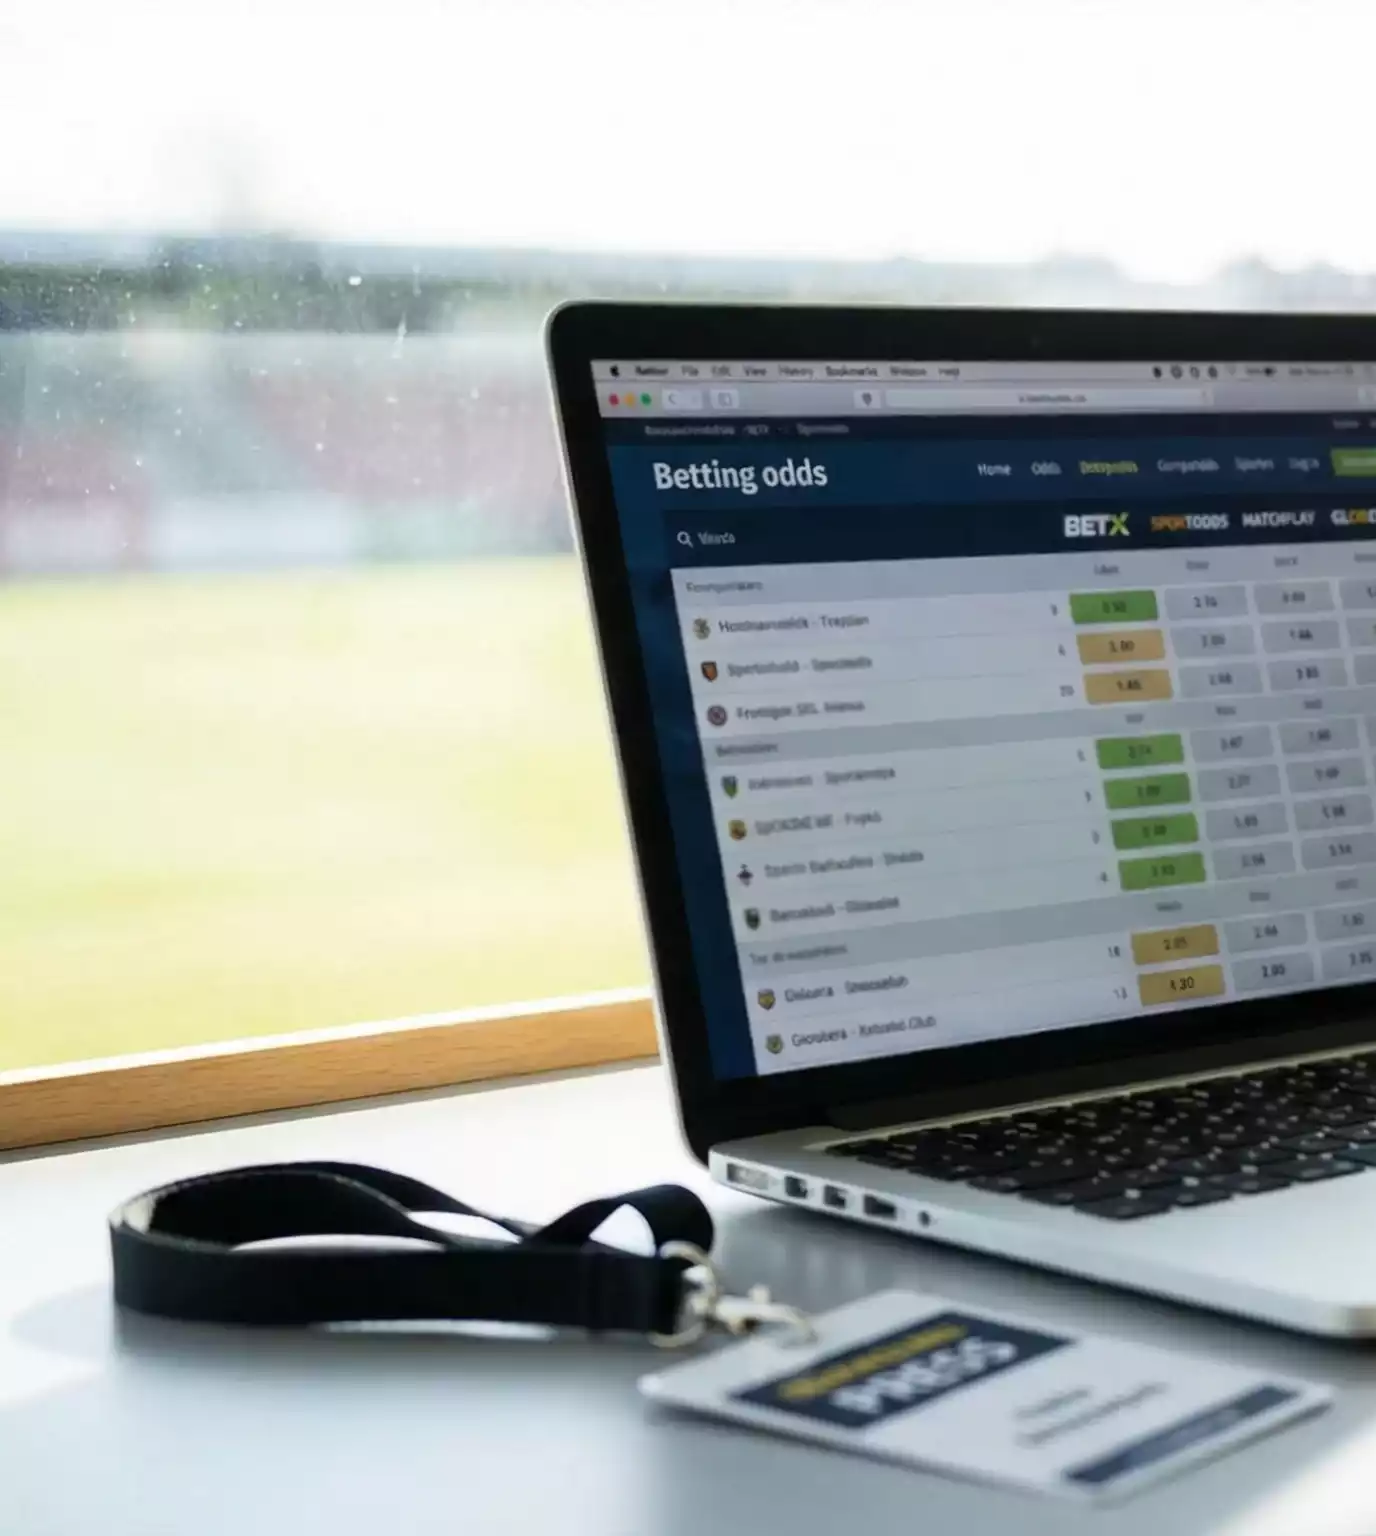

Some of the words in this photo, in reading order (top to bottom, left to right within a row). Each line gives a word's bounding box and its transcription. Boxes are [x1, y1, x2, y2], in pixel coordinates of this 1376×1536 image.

[652, 460, 758, 495] Betting
[762, 458, 829, 488] odds
[977, 462, 1012, 477] Home
[1064, 511, 1131, 538] BETX
